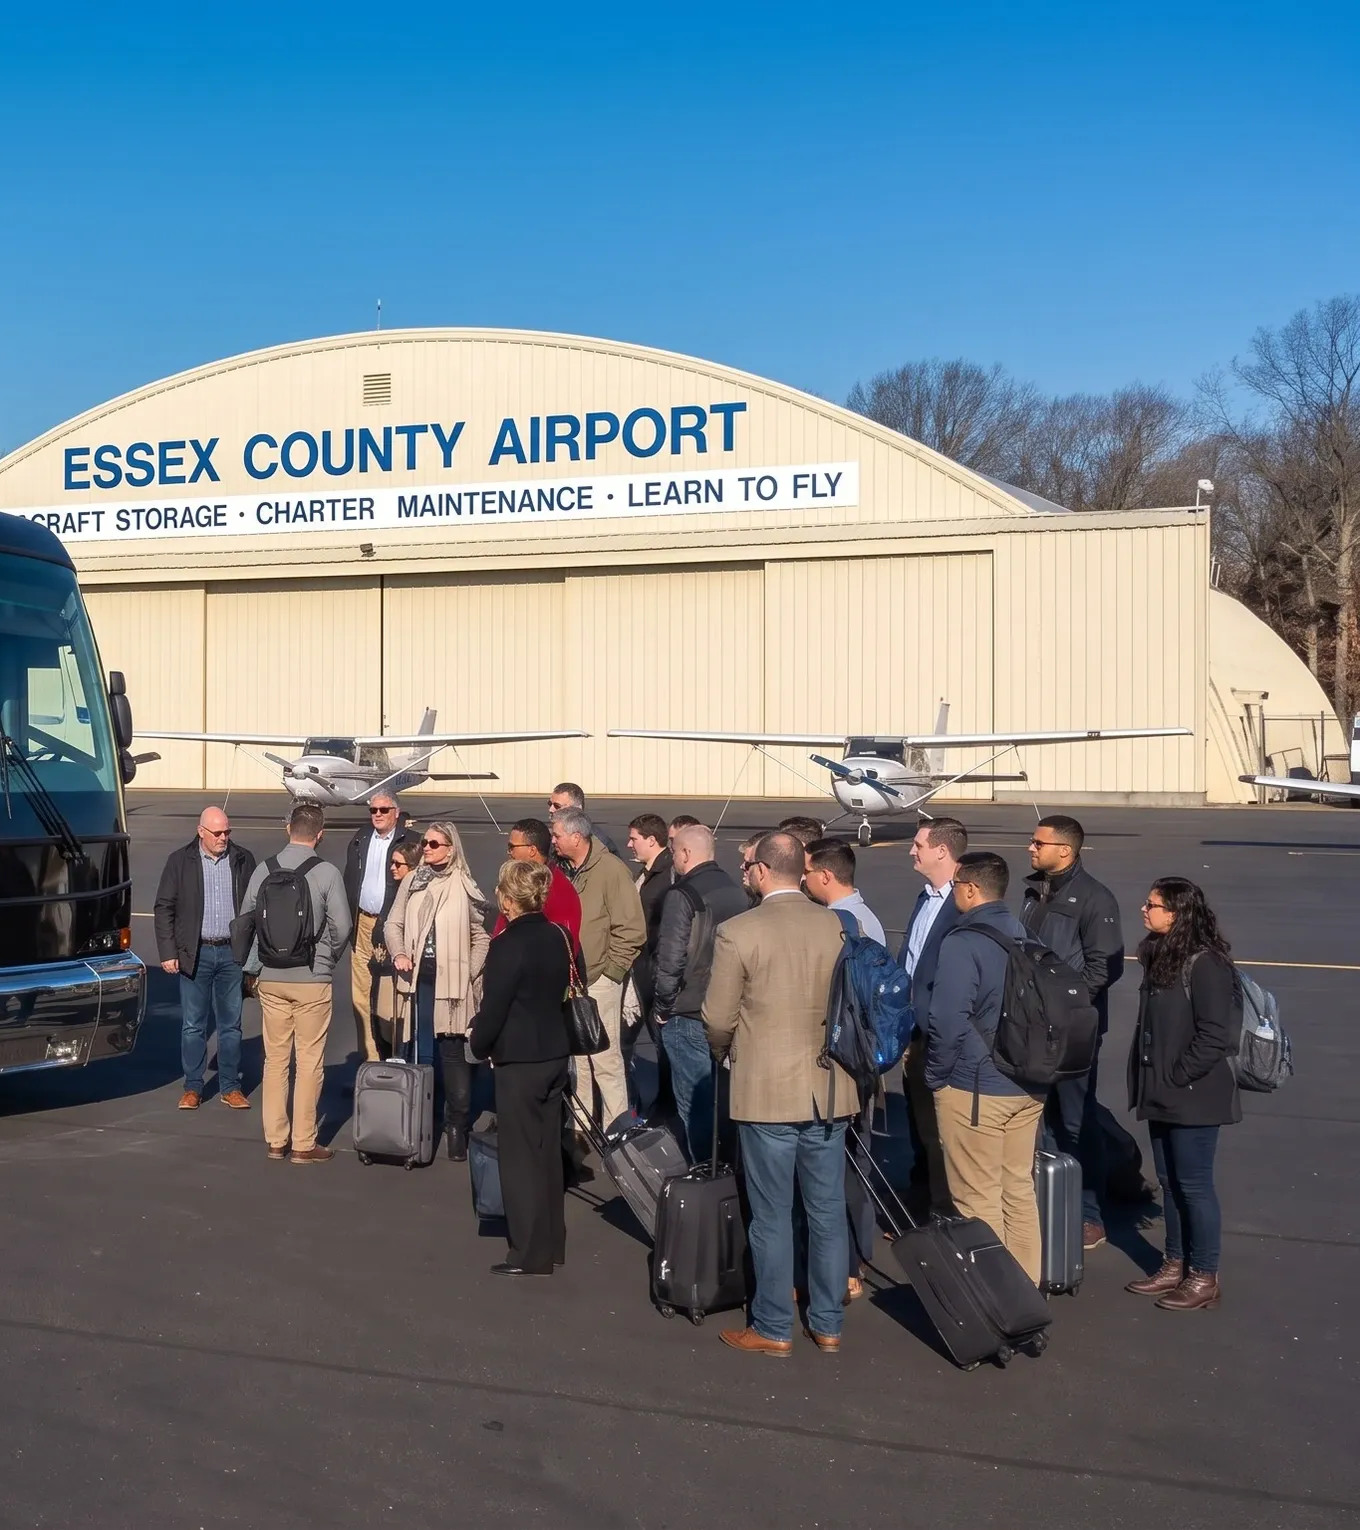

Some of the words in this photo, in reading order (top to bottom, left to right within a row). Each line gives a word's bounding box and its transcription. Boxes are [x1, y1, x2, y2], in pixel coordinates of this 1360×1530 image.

[64, 437, 221, 491] ESSEX
[243, 421, 466, 480] COUNTY
[487, 401, 747, 466] AIRPORT
[115, 504, 227, 532] STORAGE
[256, 497, 375, 525] CHARTER
[397, 485, 594, 519] MAINTENANCE
[628, 478, 723, 507] LEARN
[737, 475, 778, 502] TO
[793, 471, 843, 499] FLY
